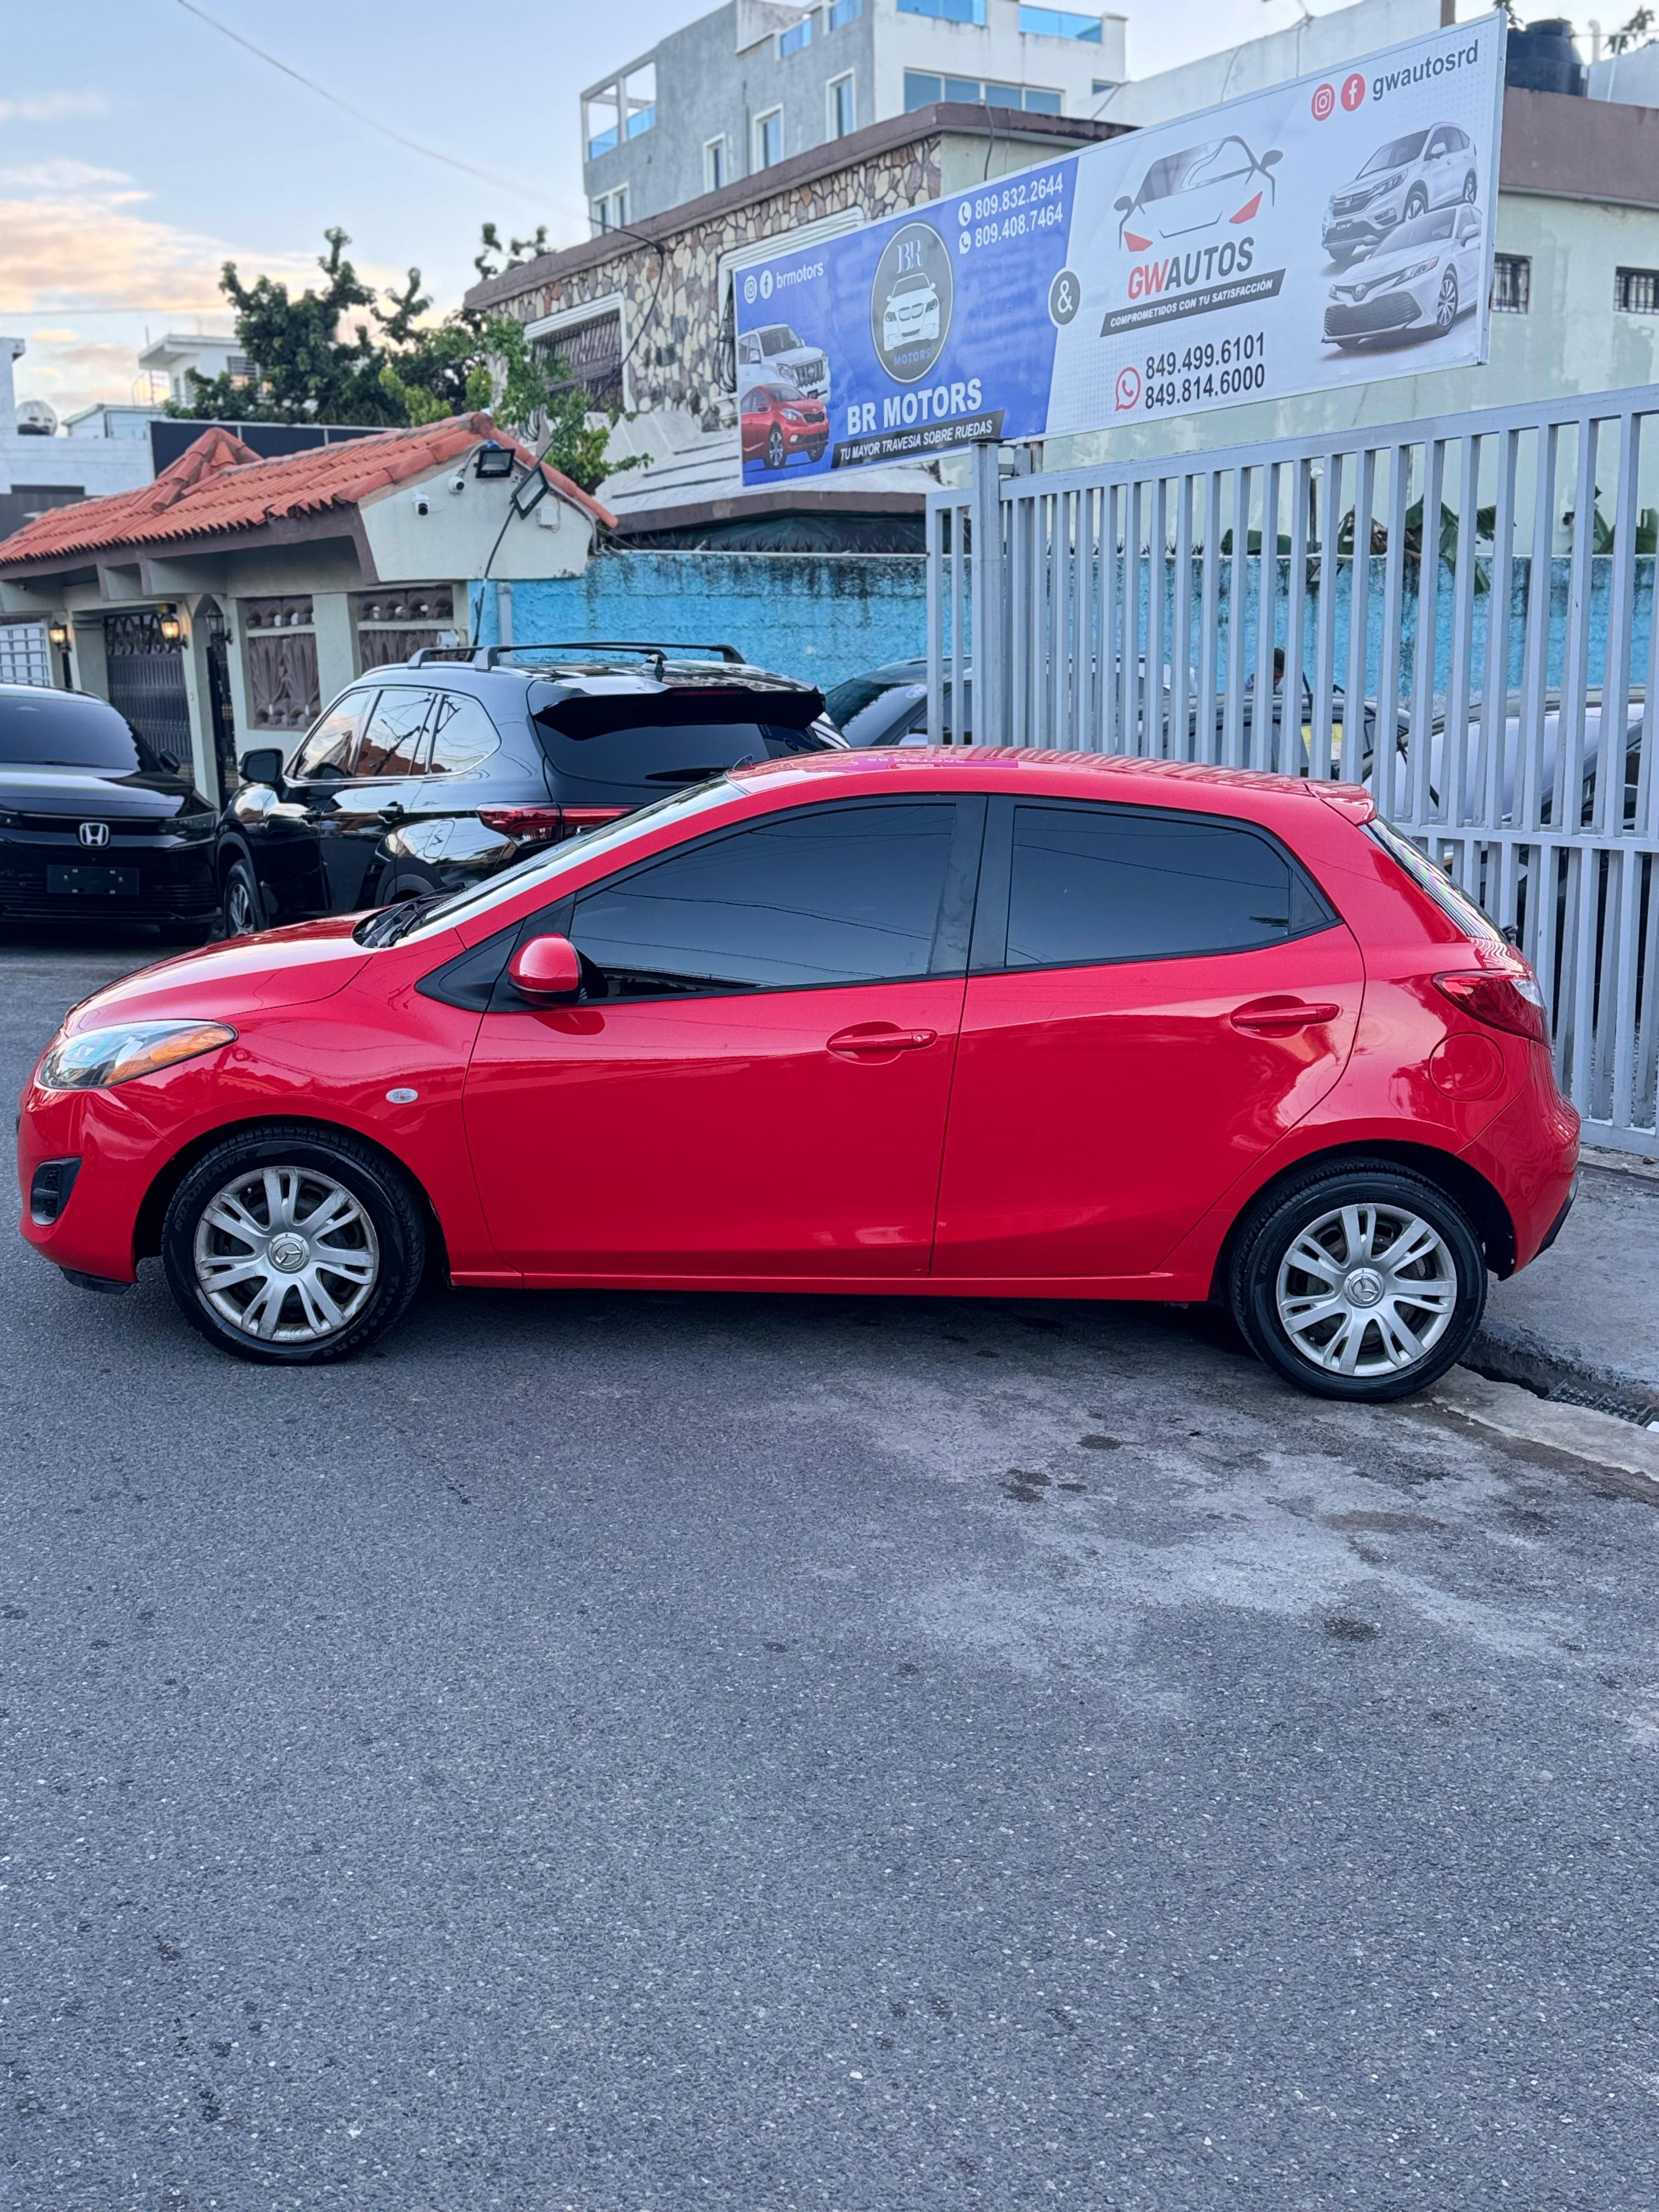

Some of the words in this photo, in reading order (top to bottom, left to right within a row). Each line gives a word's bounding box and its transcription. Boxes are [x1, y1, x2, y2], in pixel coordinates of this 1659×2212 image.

[1373, 39, 1478, 101] gwautosrd
[975, 172, 1063, 219] 809.832.2644
[975, 202, 1063, 247] 809.408.7464
[776, 262, 823, 289] brmotors
[896, 239, 922, 273] BR
[1128, 236, 1254, 300] GWAUTOS
[1110, 303, 1177, 328] COMPROMETIDOS
[1179, 297, 1196, 311] CON
[1199, 295, 1210, 307] TU
[1211, 278, 1273, 303] SATISFACCIÓN
[894, 348, 931, 366] MOTORS
[1146, 331, 1263, 380] 849.499.6101
[847, 402, 876, 436] BR
[884, 378, 982, 428] MOTORS
[1146, 363, 1265, 409] 849.814.6000
[840, 448, 850, 461] TU
[851, 442, 879, 459] MAYOR
[882, 433, 922, 453] TRAVESIA
[923, 427, 953, 444] SOBRE
[955, 420, 992, 439] RUEDAS
